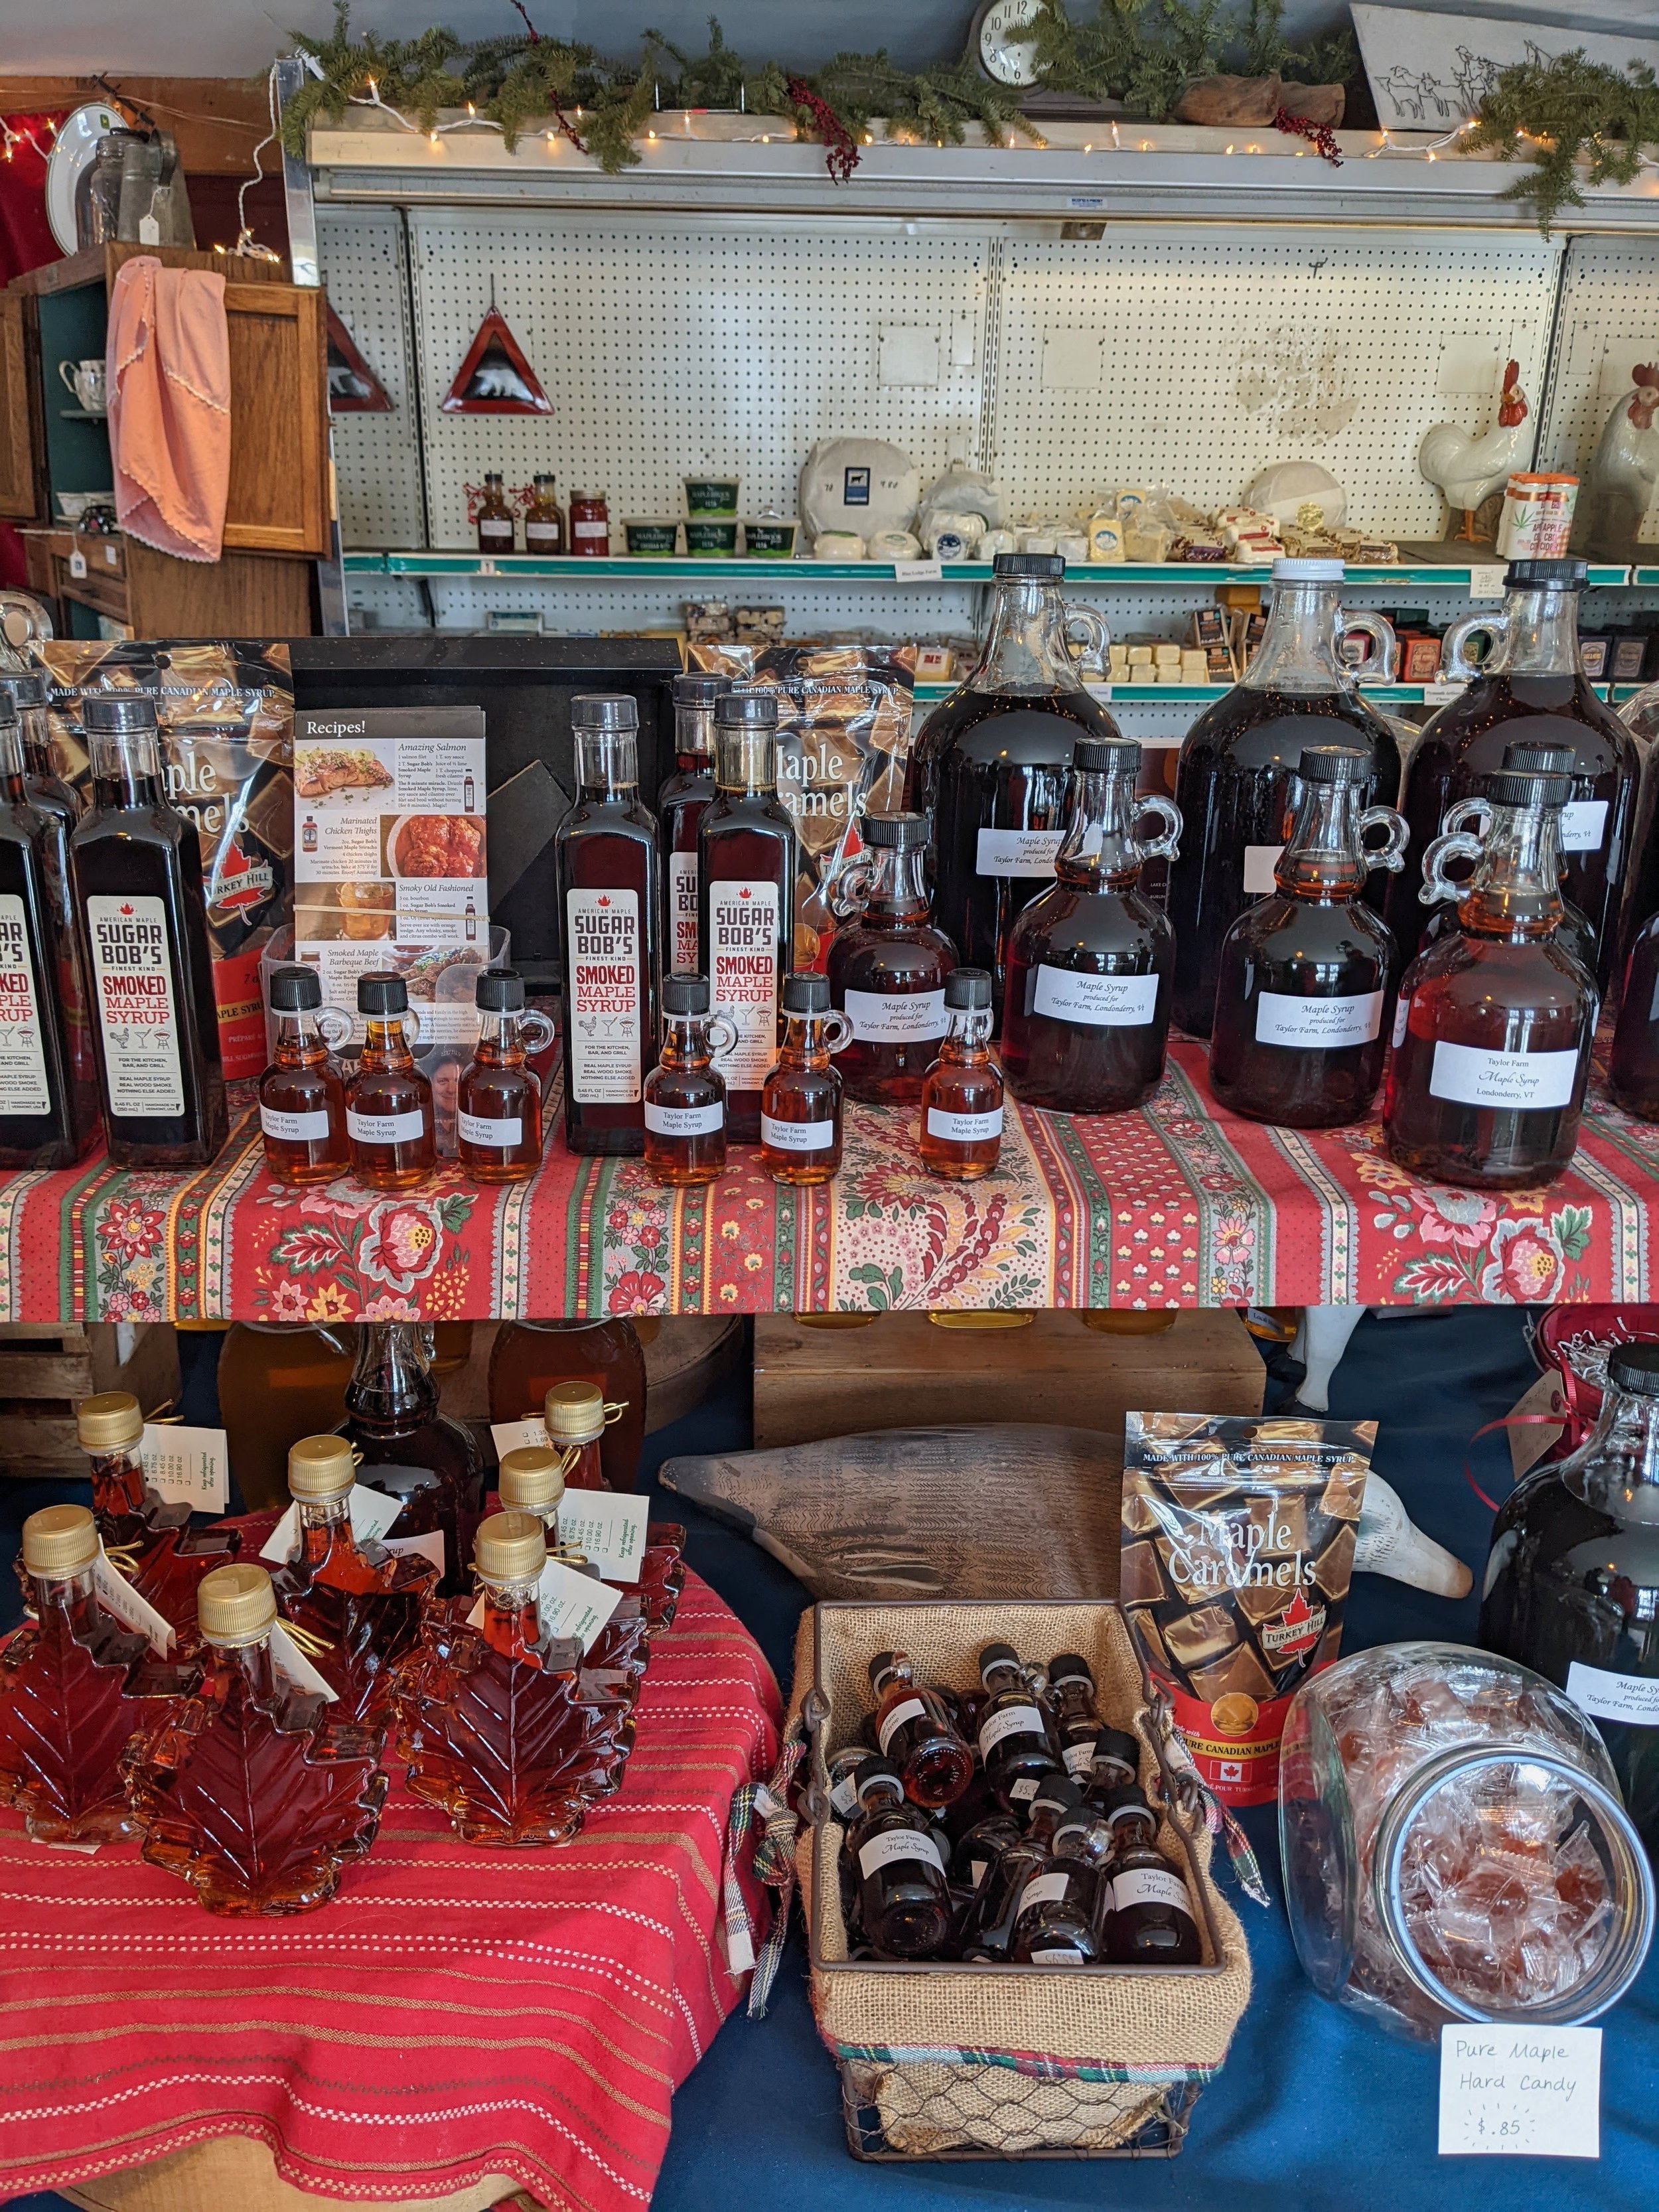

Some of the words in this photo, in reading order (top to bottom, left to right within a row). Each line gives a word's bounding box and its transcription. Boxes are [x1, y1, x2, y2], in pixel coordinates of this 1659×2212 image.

[1004, 5, 1011, 18] 11
[1017, 1, 1027, 15] 12
[991, 17, 1001, 31] 10
[984, 33, 991, 46] 9
[989, 48, 997, 63] 8
[1014, 68, 1021, 80] 6
[50, 688, 78, 698] MADE
[135, 687, 159, 696] PURE
[161, 686, 208, 696] CANADIAN
[211, 686, 242, 698] MAPLE
[244, 688, 275, 698] SYRUP
[777, 686, 800, 695] PURE
[802, 686, 842, 695] CANADIAN
[845, 686, 871, 695] MAPLE
[873, 686, 899, 696] SYRUP
[307, 721, 366, 737] Recipes!
[398, 743, 435, 753] Amazing
[435, 743, 467, 751] Salmon
[354, 827, 378, 836] Thighs
[1017, 836, 1041, 847] Maple
[994, 856, 1013, 865] Taylor
[399, 885, 423, 893] Smoky
[716, 907, 774, 926] SUGAR
[574, 915, 635, 934] SUGAR
[96, 924, 163, 944] SUGAR
[719, 927, 772, 946] BOB'S
[577, 936, 632, 955] BOB'S
[101, 945, 162, 965] BOB'S
[357, 949, 379, 958] Maple
[329, 958, 364, 967] Barbeque
[366, 958, 380, 967] Beef
[716, 956, 773, 975] SMOKED
[576, 965, 635, 985] SMOKED
[102, 975, 167, 996] SMOKED
[717, 976, 773, 988] MAPLE
[1076, 981, 1104, 991] Maple
[1104, 984, 1129, 994] Syrup
[577, 986, 636, 997] MAPLE
[715, 989, 774, 1002] SYRUP
[105, 997, 169, 1009] MAPLE
[1051, 997, 1072, 1007] Taylor
[1073, 1001, 1092, 1011] Farm,
[1094, 1004, 1135, 1014] Londonderry,
[1109, 995, 1119, 1003] for
[576, 999, 636, 1013] SYRUP
[882, 1001, 908, 1012] Maple
[908, 1001, 931, 1012] Syrup
[106, 1010, 171, 1025] SYRUP
[889, 1013, 914, 1022] produced
[859, 1021, 880, 1031] Taylor
[901, 1020, 939, 1031] Londonderry,
[1488, 1057, 1510, 1067] Taylor
[1479, 1070, 1514, 1086] Maple
[1515, 1073, 1540, 1087] Syrup
[1477, 1088, 1522, 1100] Londonderry,
[663, 1112, 684, 1120] Taylor
[357, 1118, 376, 1128] Taylor
[662, 1120, 682, 1129] Maple
[684, 1120, 702, 1129] Syrup
[772, 1123, 788, 1134] Taylor
[952, 1118, 973, 1128] Taylor
[770, 1132, 788, 1142] Maple
[788, 1134, 808, 1143] Syrup
[1143, 1453, 1169, 1462] MADE
[1169, 1453, 1195, 1462] WITH
[1221, 1453, 1246, 1462] PURE
[1247, 1453, 1292, 1462] CANADIAN
[1293, 1454, 1323, 1463] MAPLE
[1325, 1454, 1354, 1463] SYRUP
[1197, 1509, 1292, 1556] Maple
[1168, 1549, 1317, 1587] Caramels
[1265, 1626, 1304, 1643] TURKEY
[1307, 1617, 1324, 1634] HILL
[1616, 1681, 1646, 1694] Maple
[1587, 1694, 1611, 1705] Taylor
[1612, 1700, 1634, 1711] Farm,
[1206, 1744, 1252, 1756] CANADIAN
[1254, 1742, 1281, 1754] MAPLE
[882, 1841, 910, 1854] Maple
[910, 1842, 930, 1855] Syrup
[1141, 1872, 1167, 1882] Taylor
[1137, 1883, 1171, 1897] Maple
[1457, 2040, 1498, 2057] Pure
[1508, 2042, 1569, 2063] Maple
[1460, 2071, 1506, 2091] Hard
[1520, 2075, 1577, 2102] Candy
[1478, 2117, 1520, 2136] $.85
